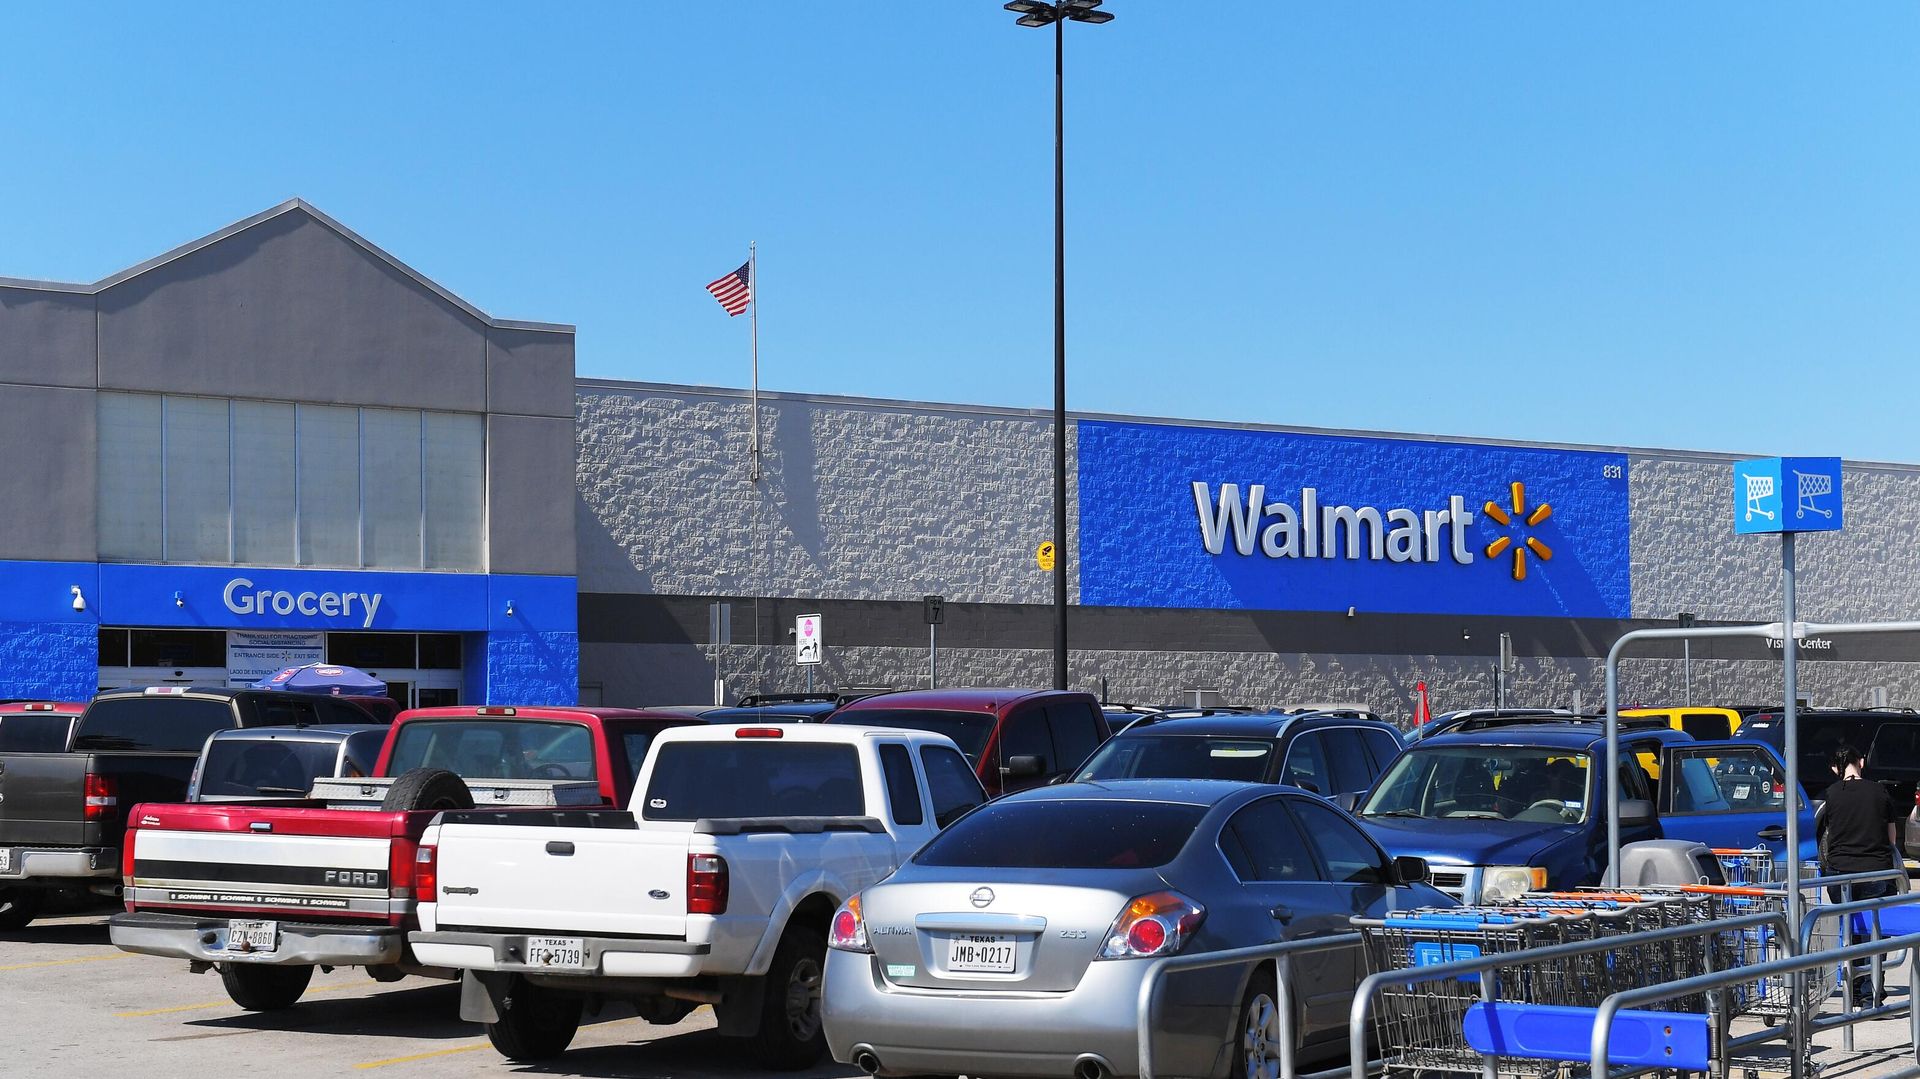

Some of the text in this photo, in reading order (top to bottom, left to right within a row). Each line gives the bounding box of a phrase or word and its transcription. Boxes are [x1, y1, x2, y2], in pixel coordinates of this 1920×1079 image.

[1603, 465, 1621, 479] 831
[1192, 481, 1474, 565] Walmart
[223, 577, 382, 628] Grocery
[932, 607, 940, 621] 7
[1798, 638, 1832, 650] Center
[324, 870, 378, 885] FORD
[177, 893, 212, 901] SCHWINN
[264, 897, 301, 905] SCHWINN
[310, 899, 347, 907] SCHWINN
[873, 926, 912, 936] ALTIMA
[969, 936, 996, 944] TEXAS
